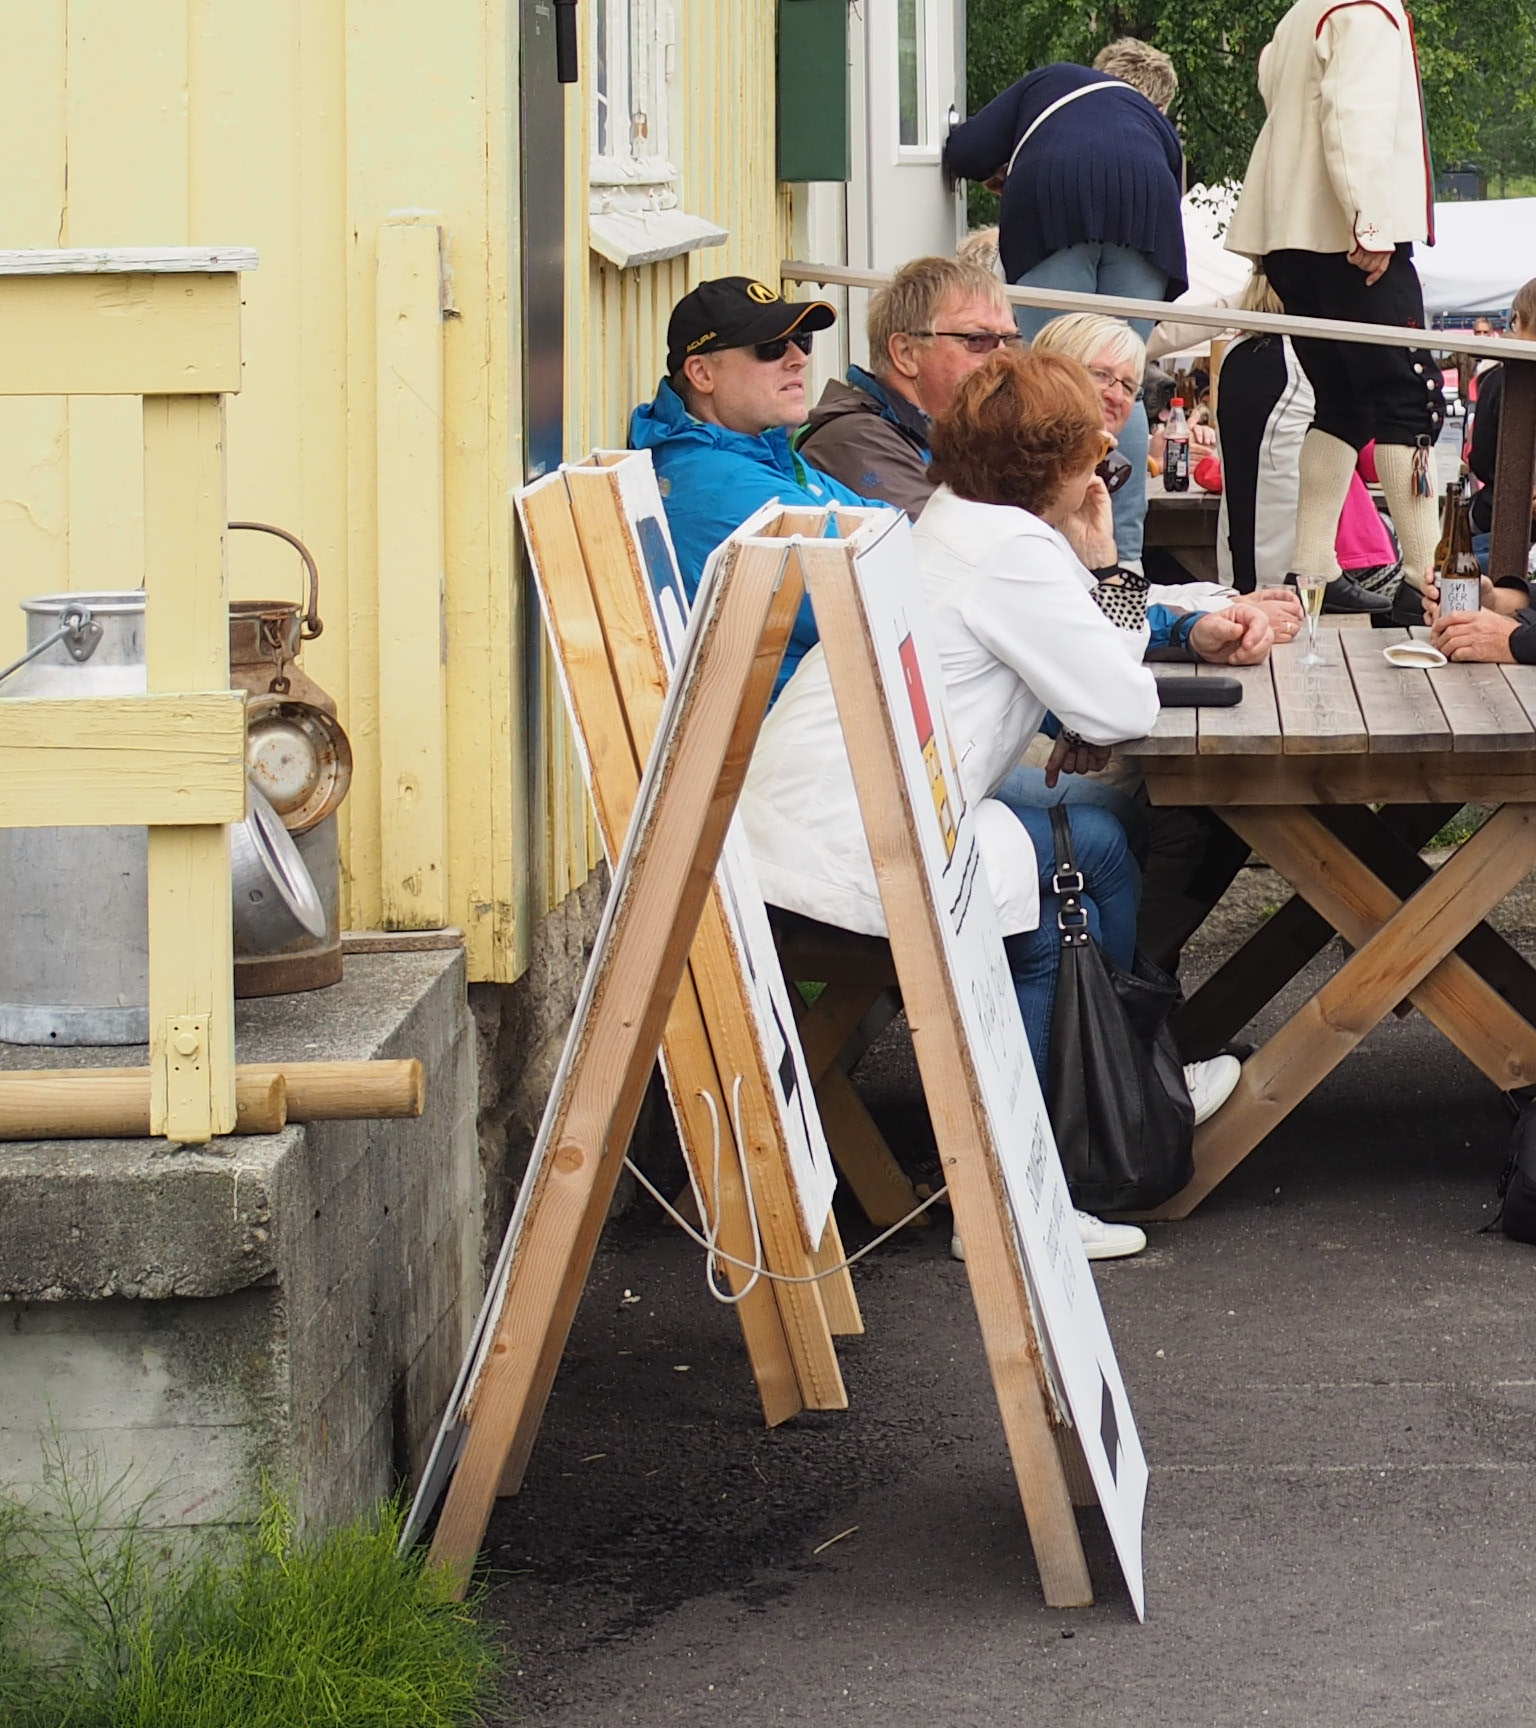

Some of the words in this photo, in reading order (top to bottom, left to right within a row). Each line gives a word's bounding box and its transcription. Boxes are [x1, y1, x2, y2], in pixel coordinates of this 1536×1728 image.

[686, 331, 717, 353] ACURA
[1450, 583, 1466, 592] SVI
[1447, 592, 1468, 602] GER
